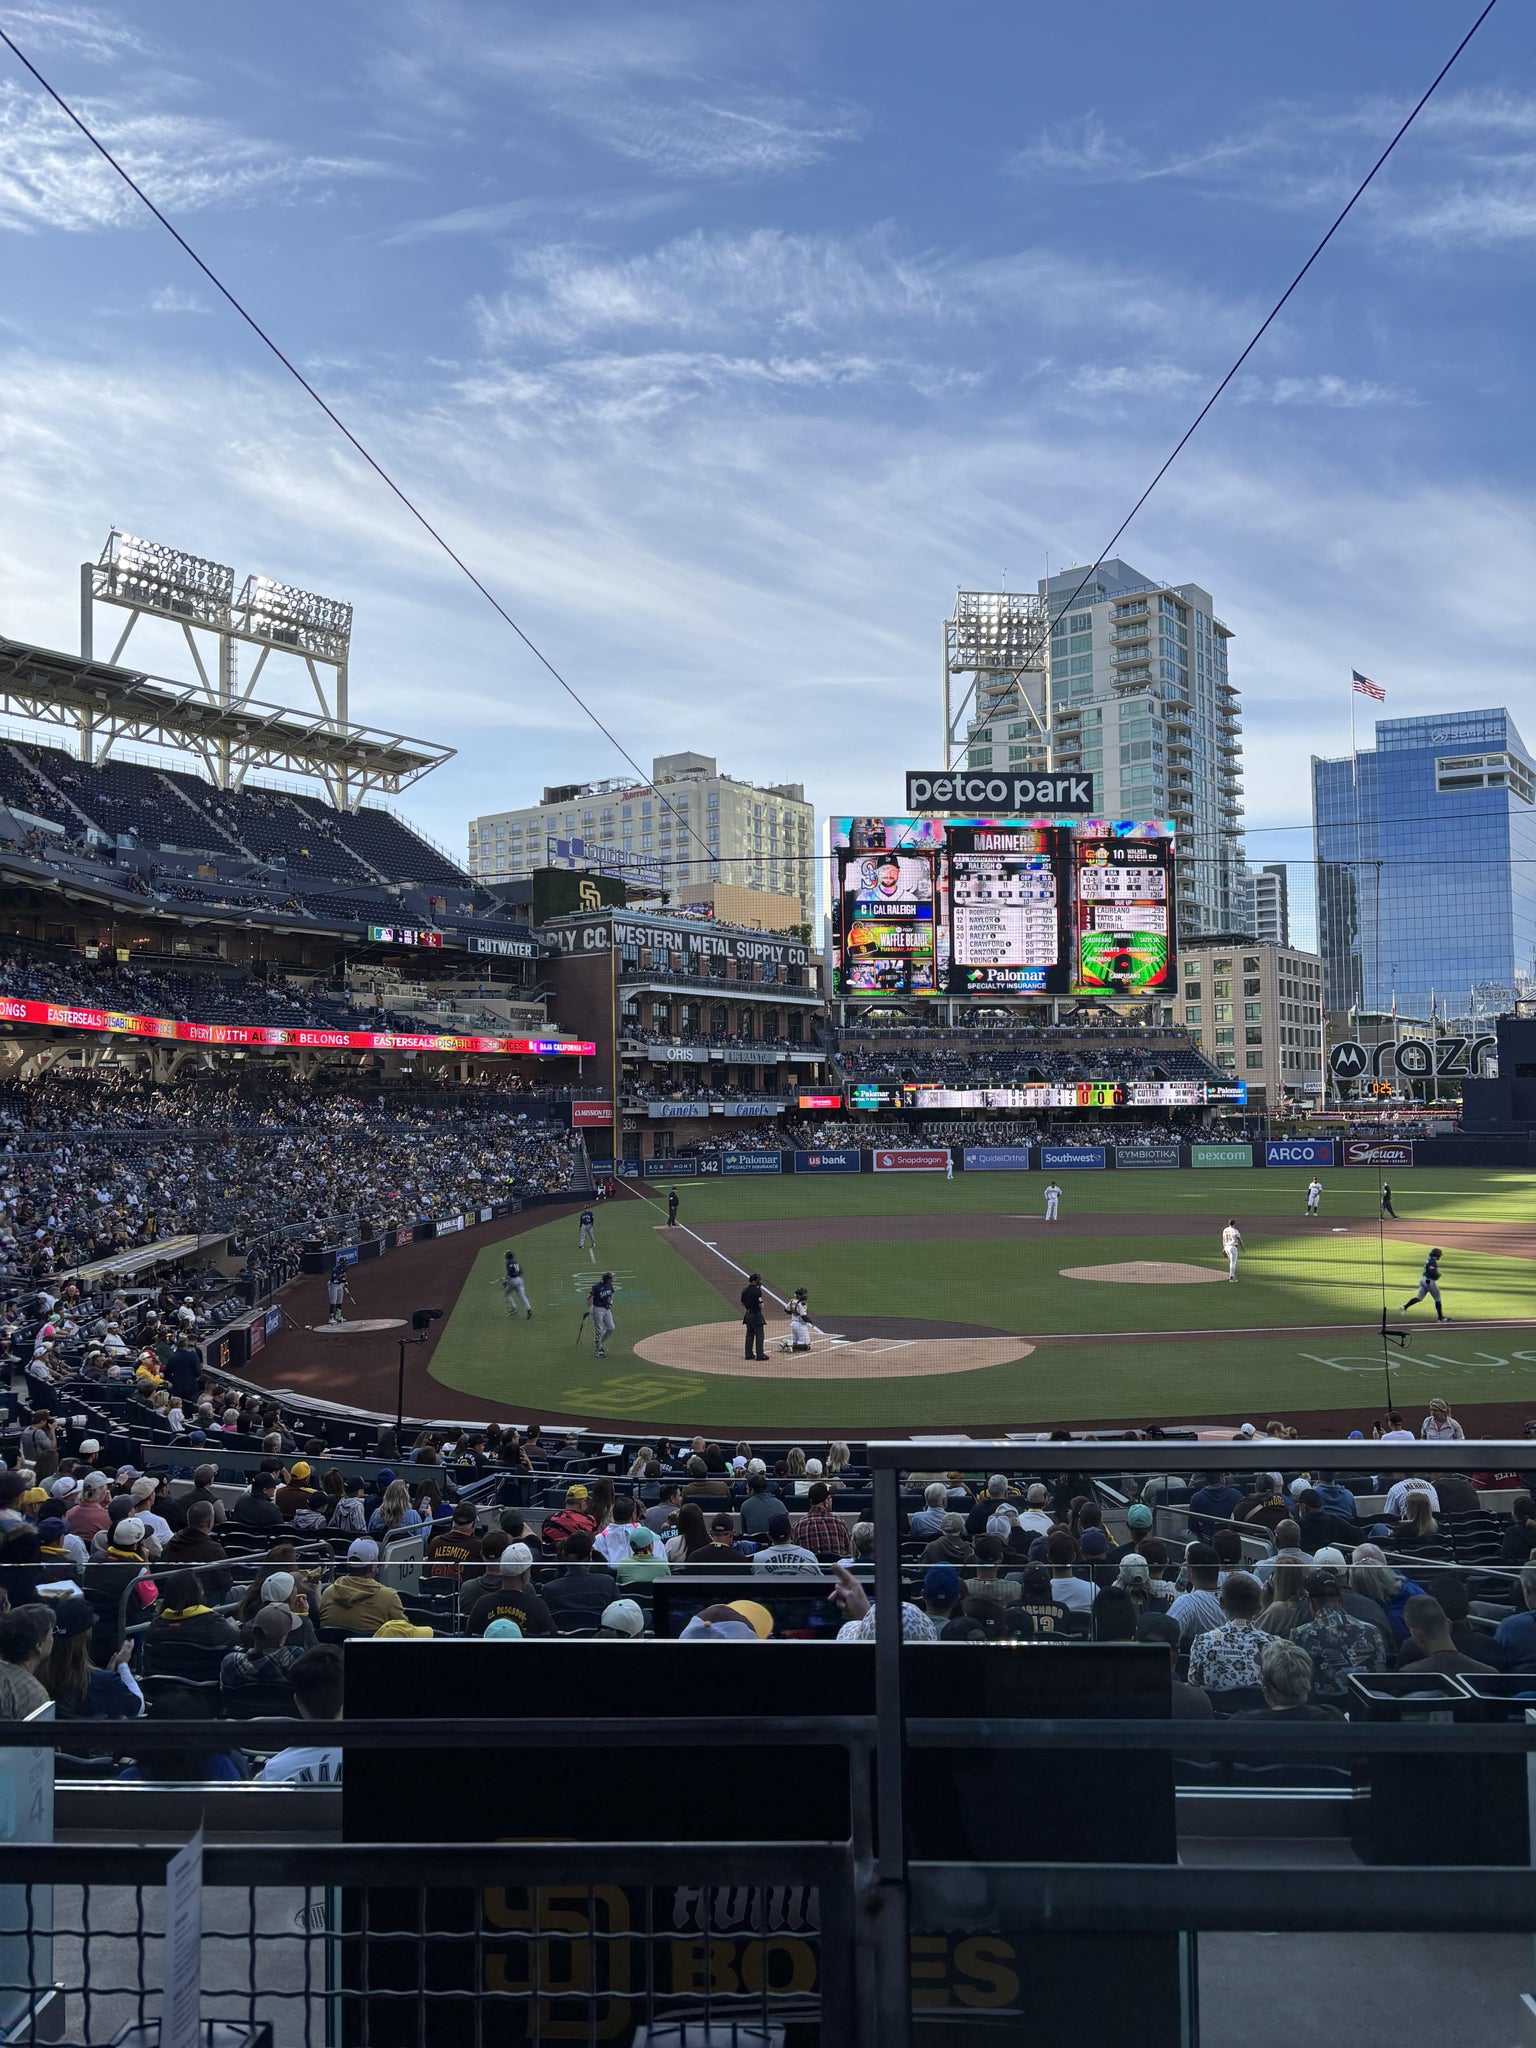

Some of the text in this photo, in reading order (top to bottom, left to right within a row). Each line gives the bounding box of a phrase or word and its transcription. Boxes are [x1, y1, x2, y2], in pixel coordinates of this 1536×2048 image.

[621, 787, 652, 801] Marriott
[910, 773, 1090, 810] petco park
[973, 834, 1036, 851] MARINERS
[1113, 849, 1124, 859] 10
[955, 862, 1031, 870] 29 RALEIGH C
[861, 904, 916, 914] C CAL RALEIGH
[583, 927, 611, 950] CO.
[615, 923, 808, 966] WESTERN METAL SUPPLY CO.
[880, 934, 904, 947] WAFFLE
[478, 939, 532, 957] CUTWATER
[986, 968, 1046, 982] Palomar
[48, 1008, 102, 1026] EASTERSEALS
[104, 1016, 142, 1032] DISABILITY
[215, 1030, 248, 1041] WITH
[251, 1032, 296, 1043] AUTISM
[300, 1033, 350, 1045] BELONGS
[373, 1036, 434, 1048] EASTERSEALS
[436, 1038, 483, 1049] DISABILITY
[486, 1040, 523, 1050] SERVICES
[666, 1048, 694, 1061] ORIS
[1372, 1036, 1498, 1077] razr
[1373, 1083, 1392, 1094] 0:25
[1082, 1091, 1088, 1104] 0
[1098, 1091, 1104, 1104] 0
[622, 1118, 636, 1130] 336
[739, 1156, 778, 1164] Palomar
[979, 1154, 1026, 1162] QuidelOrtho
[1046, 1153, 1095, 1163] Southwest
[1118, 1150, 1176, 1159] CYMBIOTIKA
[1268, 1148, 1314, 1160] ARCO
[1348, 1143, 1405, 1164] Sycuan
[700, 1160, 718, 1172] 342
[822, 1156, 846, 1165] bank
[896, 1156, 942, 1166] Snapdragon
[434, 1546, 470, 1561] ALESMITH
[764, 1554, 805, 1574] GRIFFEY
[1021, 1605, 1064, 1619] ACHADO
[672, 1936, 1022, 2008] BOES
